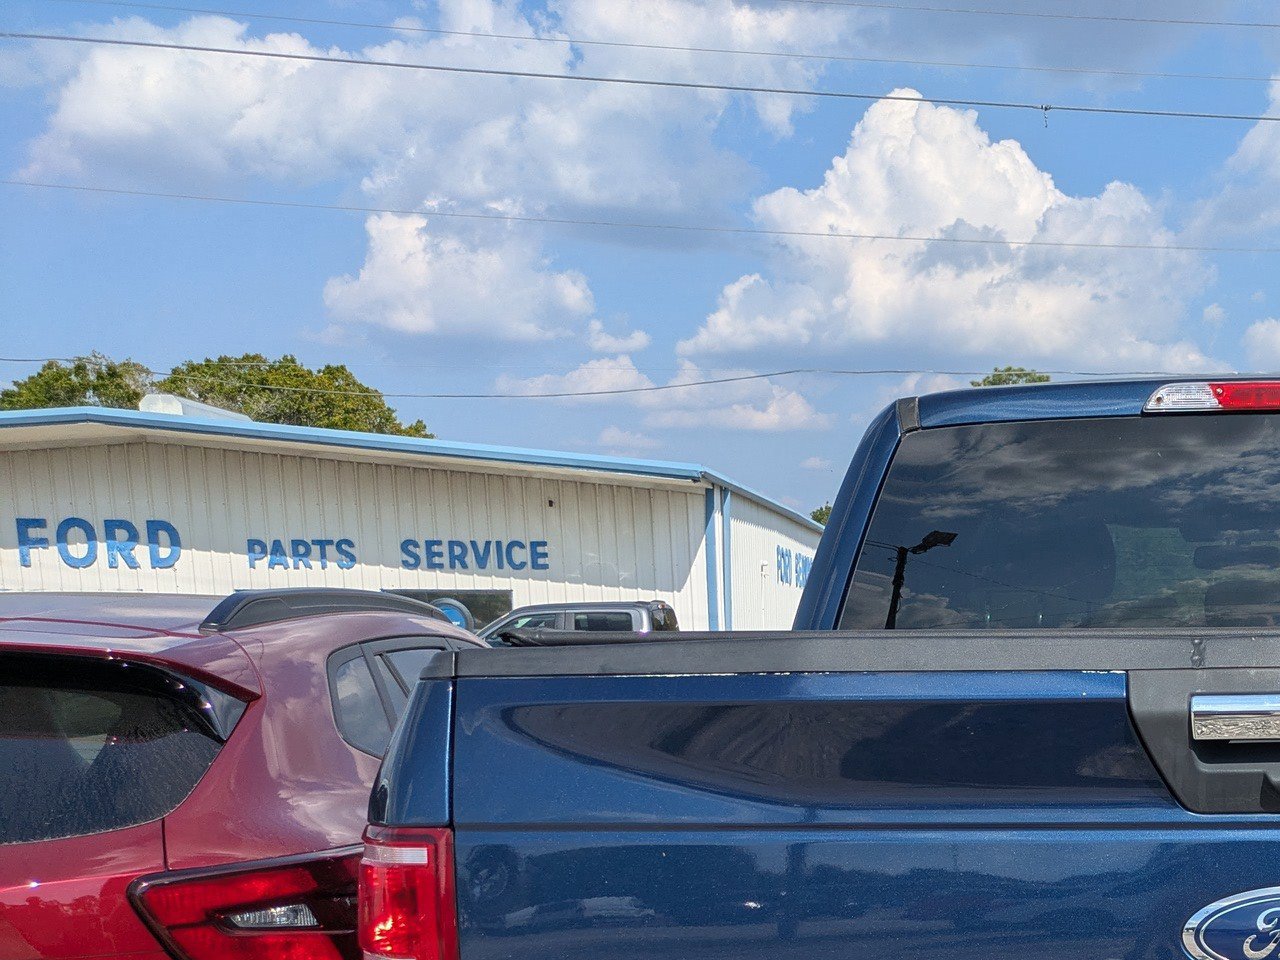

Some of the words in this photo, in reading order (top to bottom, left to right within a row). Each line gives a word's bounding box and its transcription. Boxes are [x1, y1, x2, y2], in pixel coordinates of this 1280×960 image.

[16, 517, 182, 569] FORD
[247, 538, 356, 570] PARTS
[400, 539, 549, 571] SERVICE
